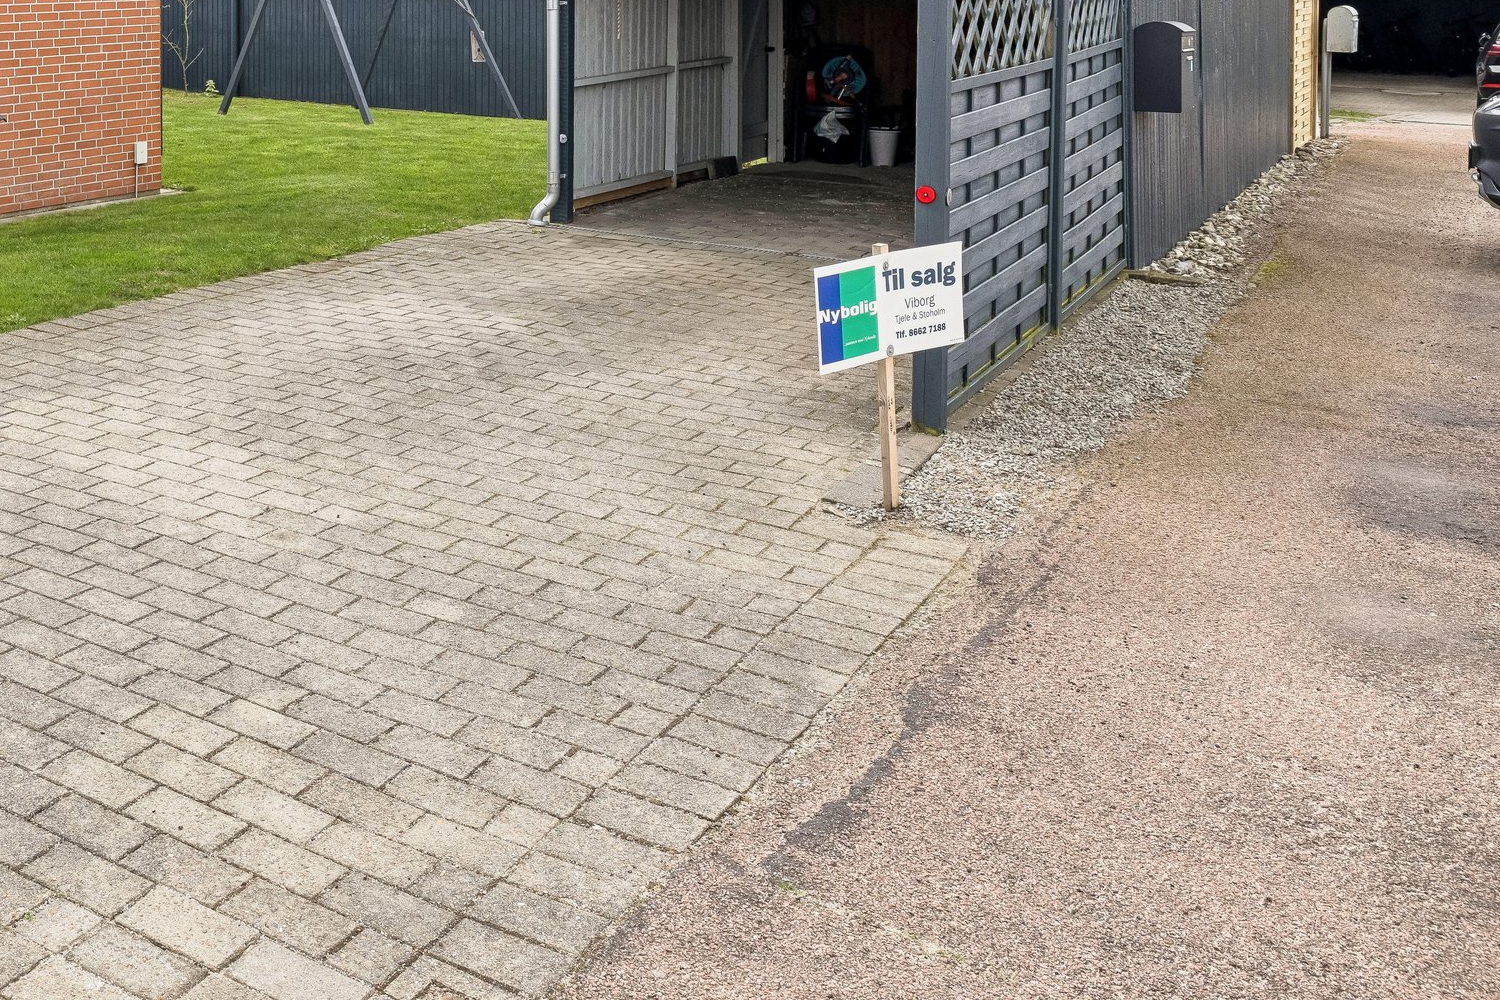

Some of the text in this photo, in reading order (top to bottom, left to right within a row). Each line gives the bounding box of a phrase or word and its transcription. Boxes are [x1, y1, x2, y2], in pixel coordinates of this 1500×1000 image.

[882, 261, 956, 292] Til salg
[904, 295, 936, 309] Viborg
[819, 300, 878, 324] Nybolig
[895, 308, 946, 325] Tjele & Stoholm
[896, 323, 947, 339] Tlf. 8662 7188
